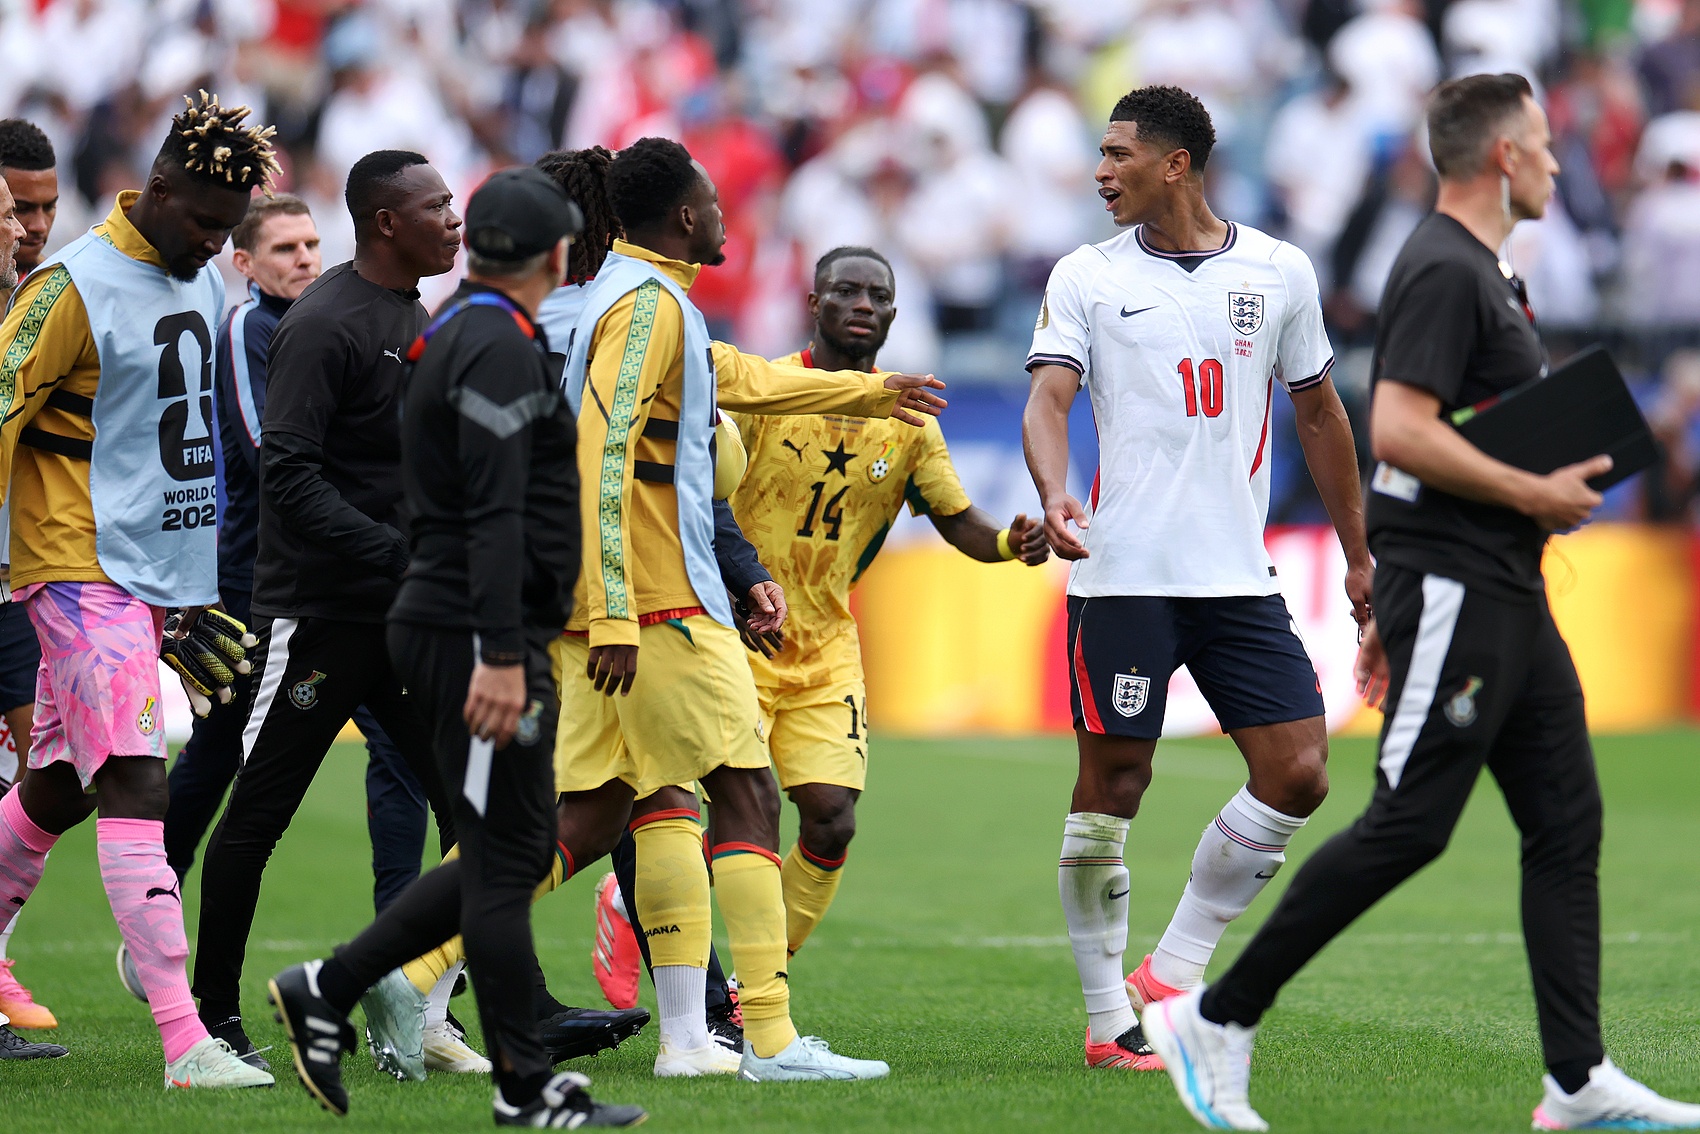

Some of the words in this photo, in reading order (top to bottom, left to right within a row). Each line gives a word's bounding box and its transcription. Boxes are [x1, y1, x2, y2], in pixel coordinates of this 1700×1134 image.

[1177, 358, 1223, 418] 10
[182, 444, 213, 466] FIFA
[163, 486, 209, 506] WORLD
[797, 481, 851, 541] 14
[844, 694, 868, 744] 1
